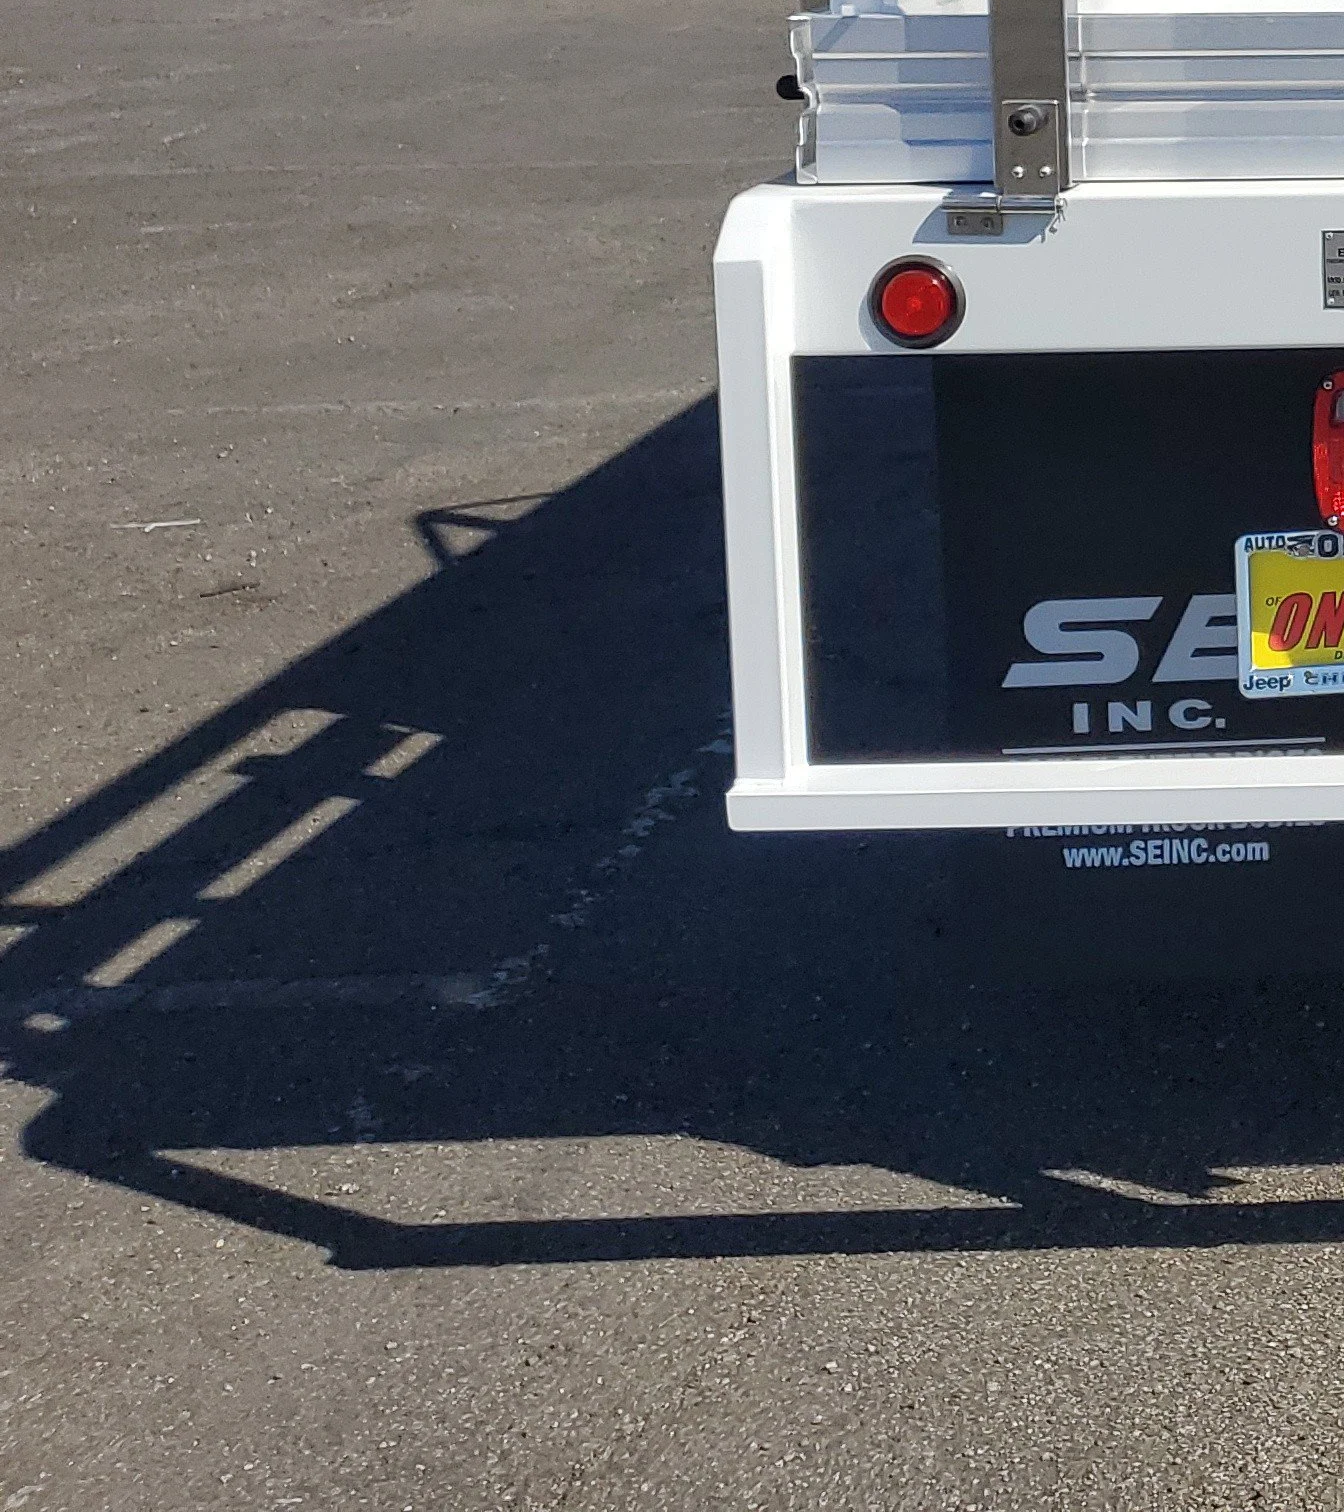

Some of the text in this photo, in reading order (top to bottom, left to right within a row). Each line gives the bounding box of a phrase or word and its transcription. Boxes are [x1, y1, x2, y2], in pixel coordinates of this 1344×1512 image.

[1244, 535, 1286, 553] AUTO
[1265, 596, 1281, 607] OF
[1001, 593, 1238, 688] SE
[1243, 675, 1292, 692] Jeep
[1072, 699, 1227, 734] INC.
[1063, 837, 1270, 868] www.SEINC.com
